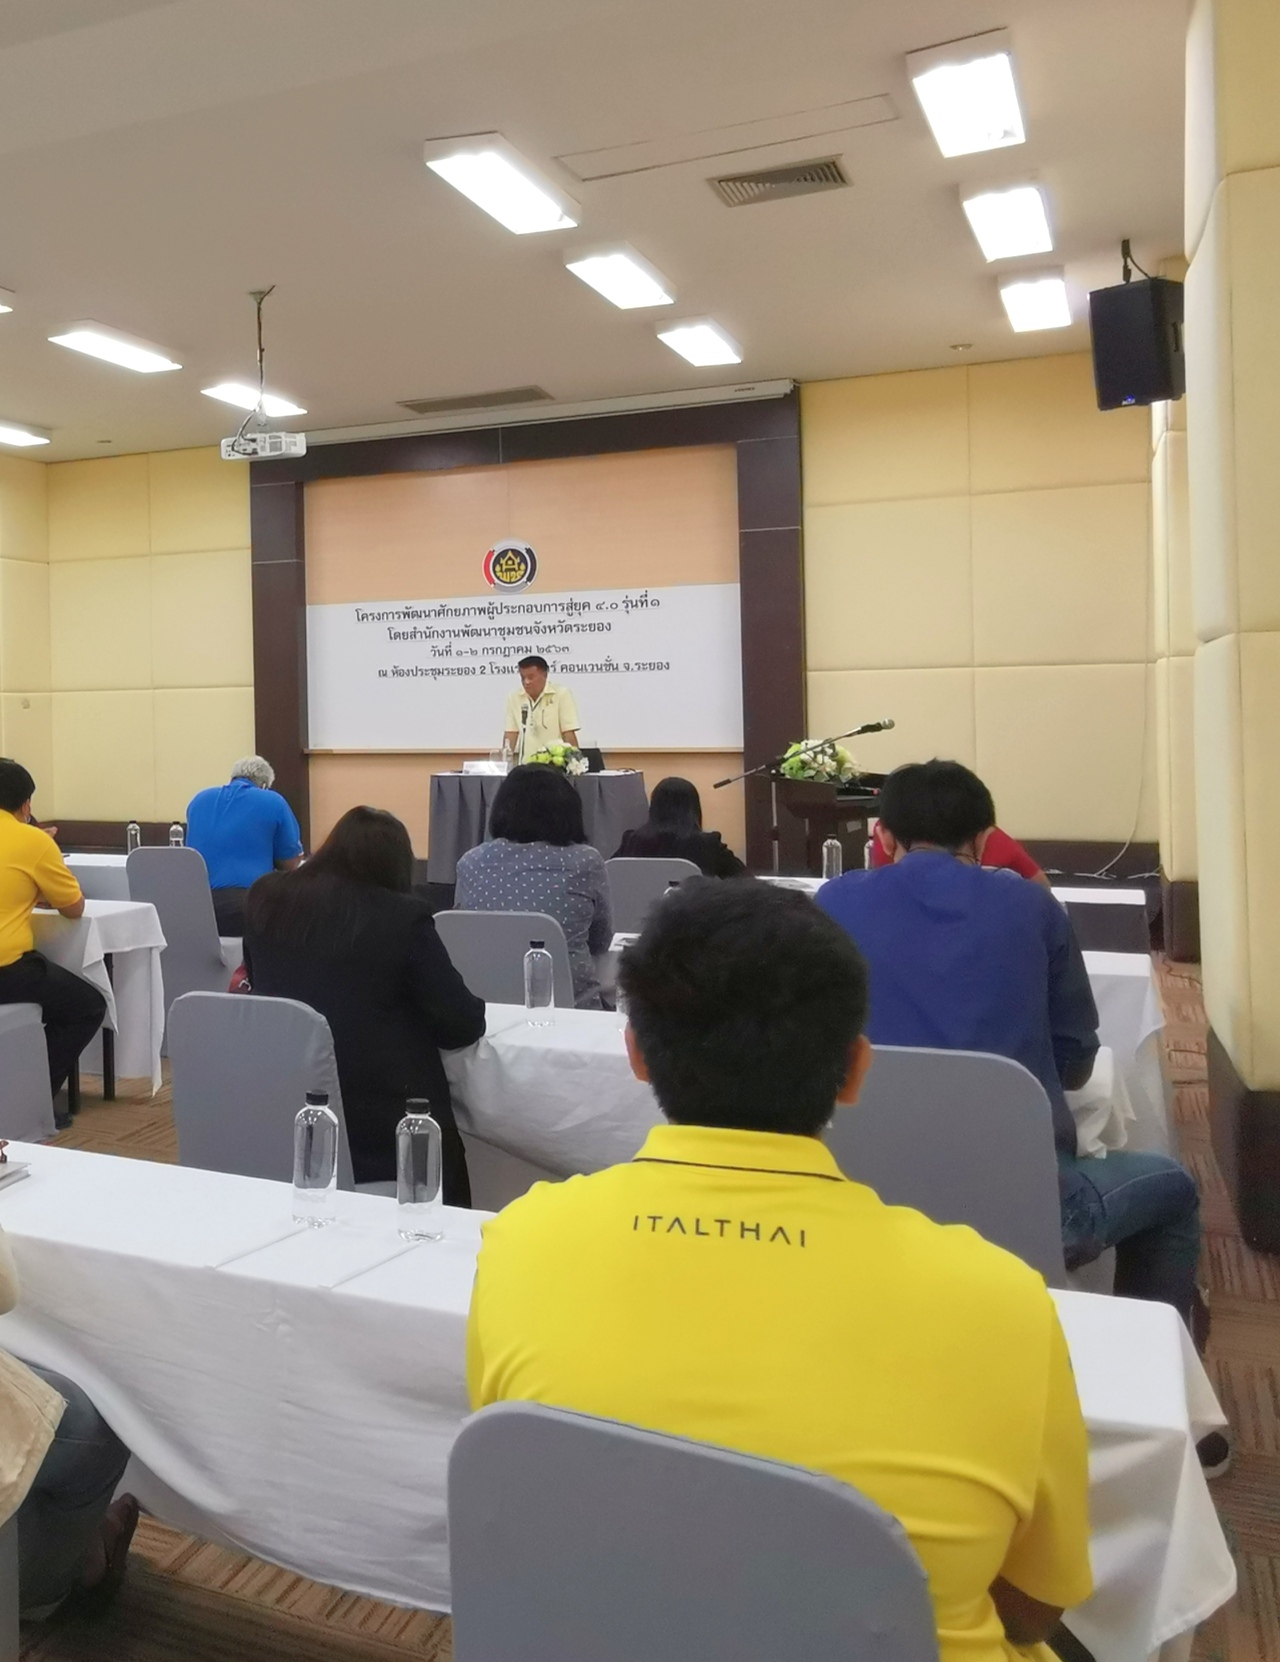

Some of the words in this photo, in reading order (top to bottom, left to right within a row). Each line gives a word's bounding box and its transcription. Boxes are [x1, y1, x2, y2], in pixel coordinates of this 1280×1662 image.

[387, 620, 612, 641] โดยสำนักงานพัฒนาชุมชนจังหวัดระยอง
[430, 642, 452, 657] วันที่
[482, 643, 532, 657] กรกฎาคม
[378, 669, 388, 678] ณ
[391, 665, 476, 681] ห้องประชุมระยอง
[479, 665, 487, 675] 2
[633, 1215, 805, 1247] ITALTHAI
